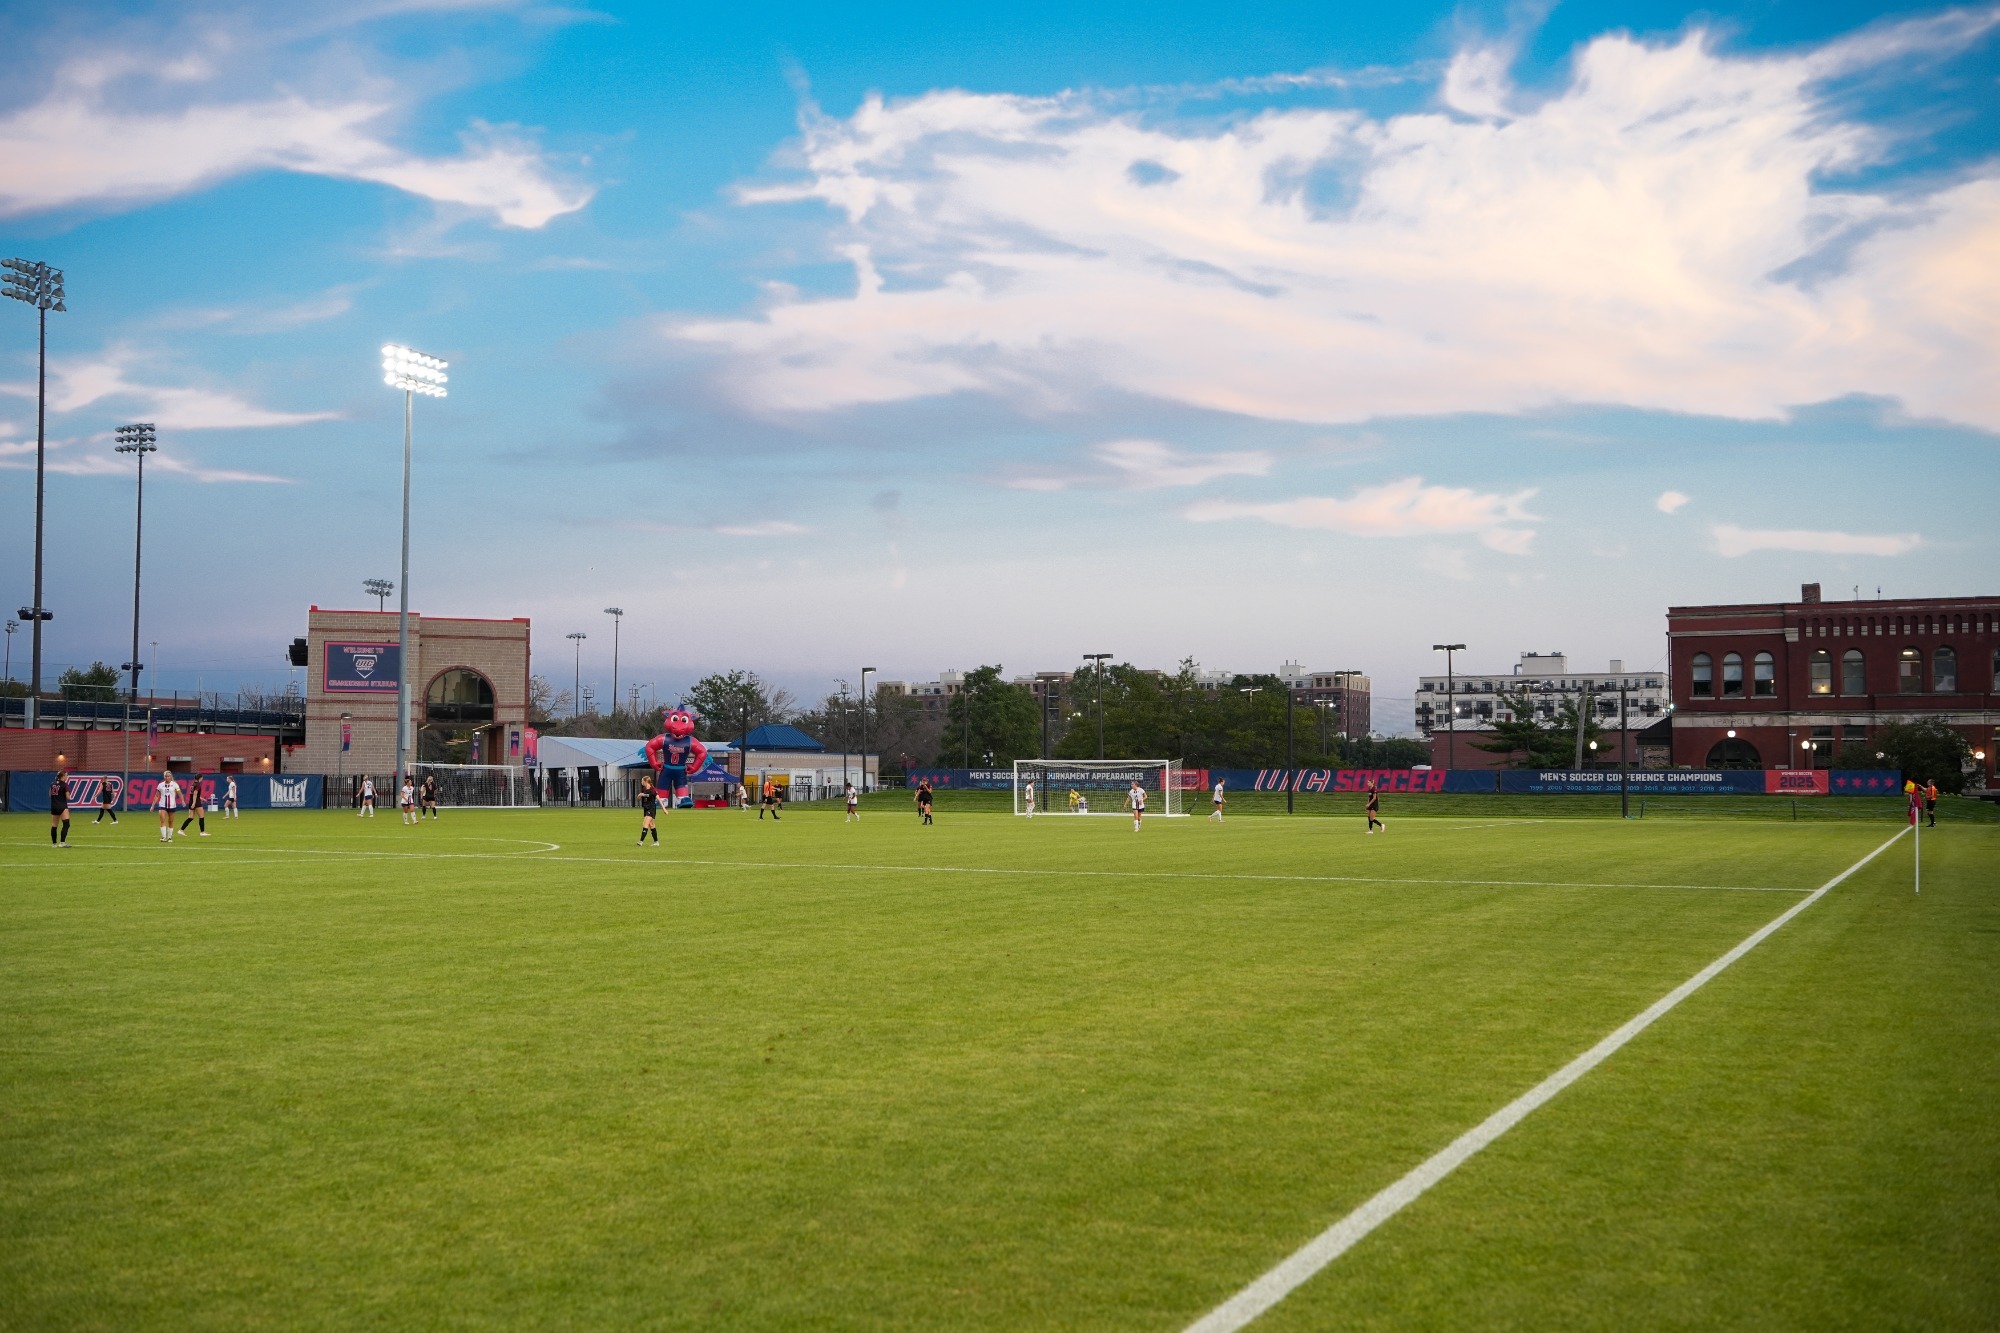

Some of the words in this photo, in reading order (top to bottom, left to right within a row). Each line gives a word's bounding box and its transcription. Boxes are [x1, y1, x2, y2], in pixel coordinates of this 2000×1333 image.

[355, 659, 375, 668] UIC
[969, 772, 991, 780] MEN'S
[1021, 772, 1040, 780] NCAA
[1091, 772, 1144, 780] APPEARANCES
[1333, 769, 1447, 793] SOCCER
[1540, 772, 1567, 781] MEN'S
[1569, 773, 1604, 782] SOCCER
[1668, 773, 1723, 782] CHAMPIONS
[1780, 776, 1814, 788] 2025
[270, 777, 308, 802] VALLEY
